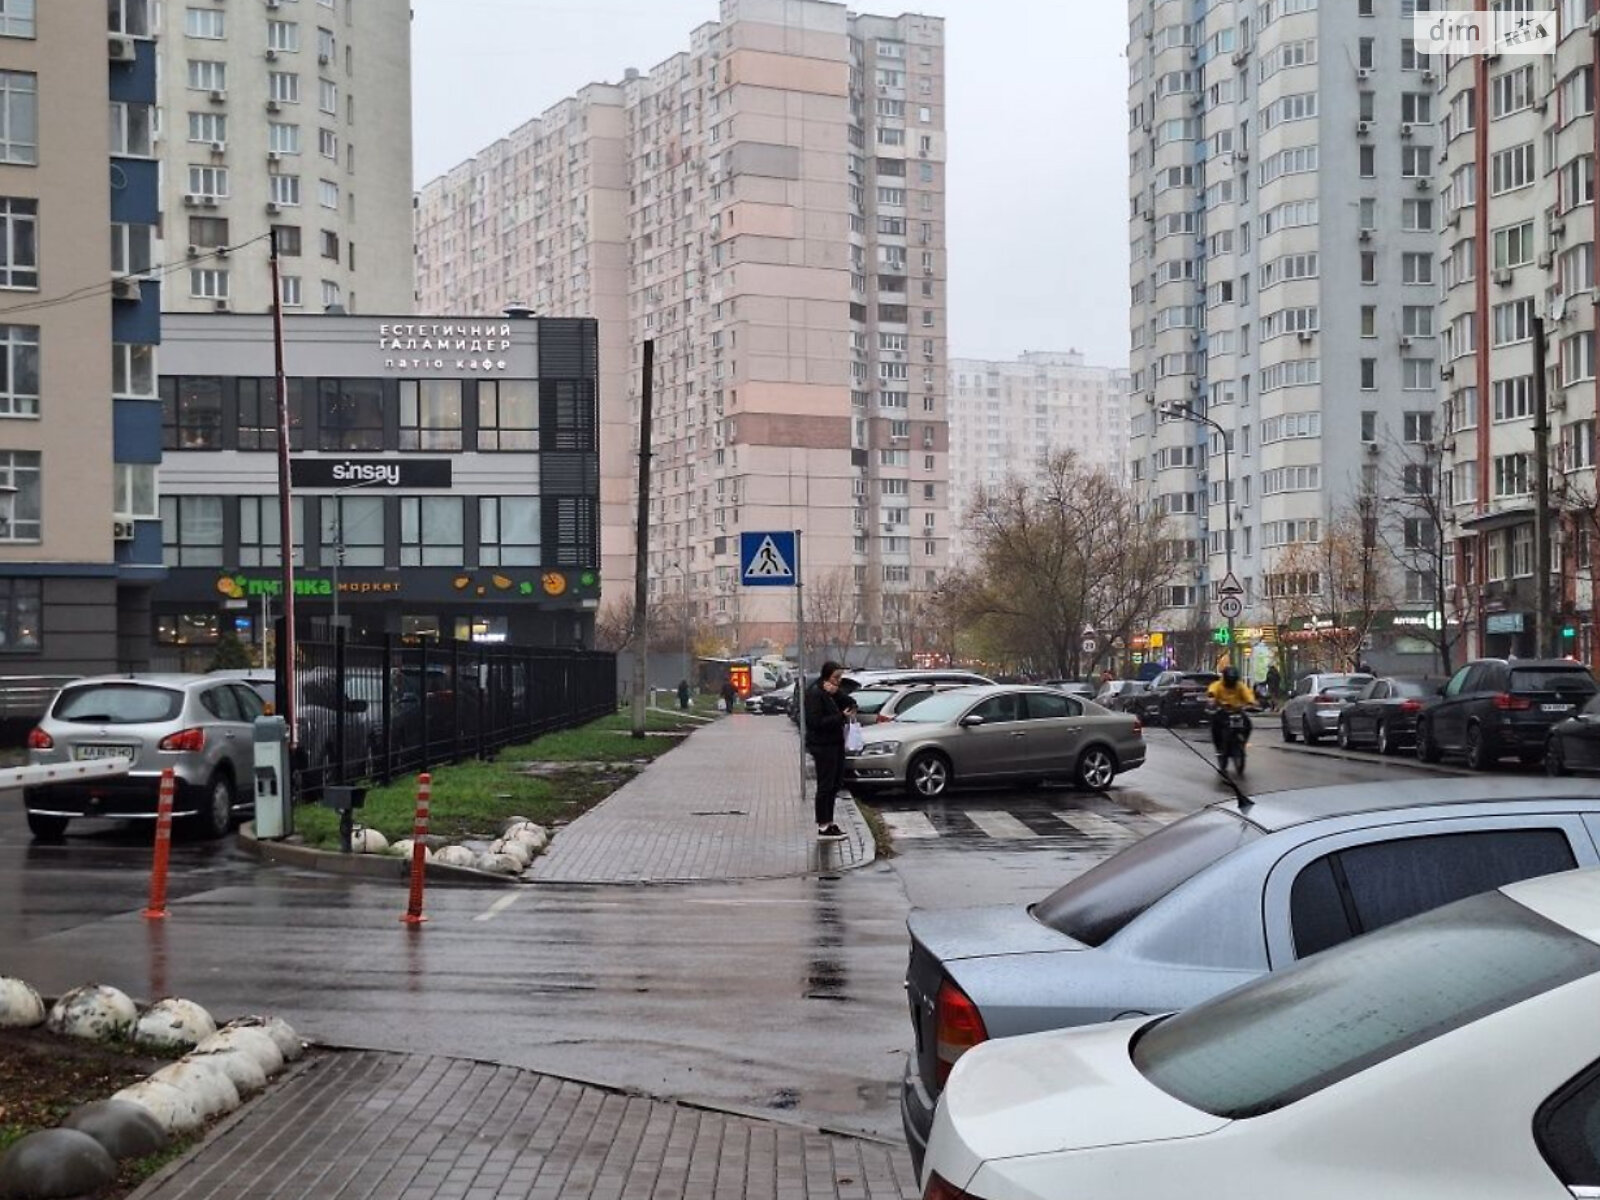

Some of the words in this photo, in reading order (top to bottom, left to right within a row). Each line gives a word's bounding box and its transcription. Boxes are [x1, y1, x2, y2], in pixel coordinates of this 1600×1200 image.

[380, 323, 510, 337] ЕСТЕТИЧНИЙ
[380, 339, 510, 352] ГАЛАМИДЕР
[456, 357, 507, 370] кафе
[332, 461, 400, 485] sinsay
[337, 582, 401, 593] маркет
[1223, 601, 1238, 612] 40
